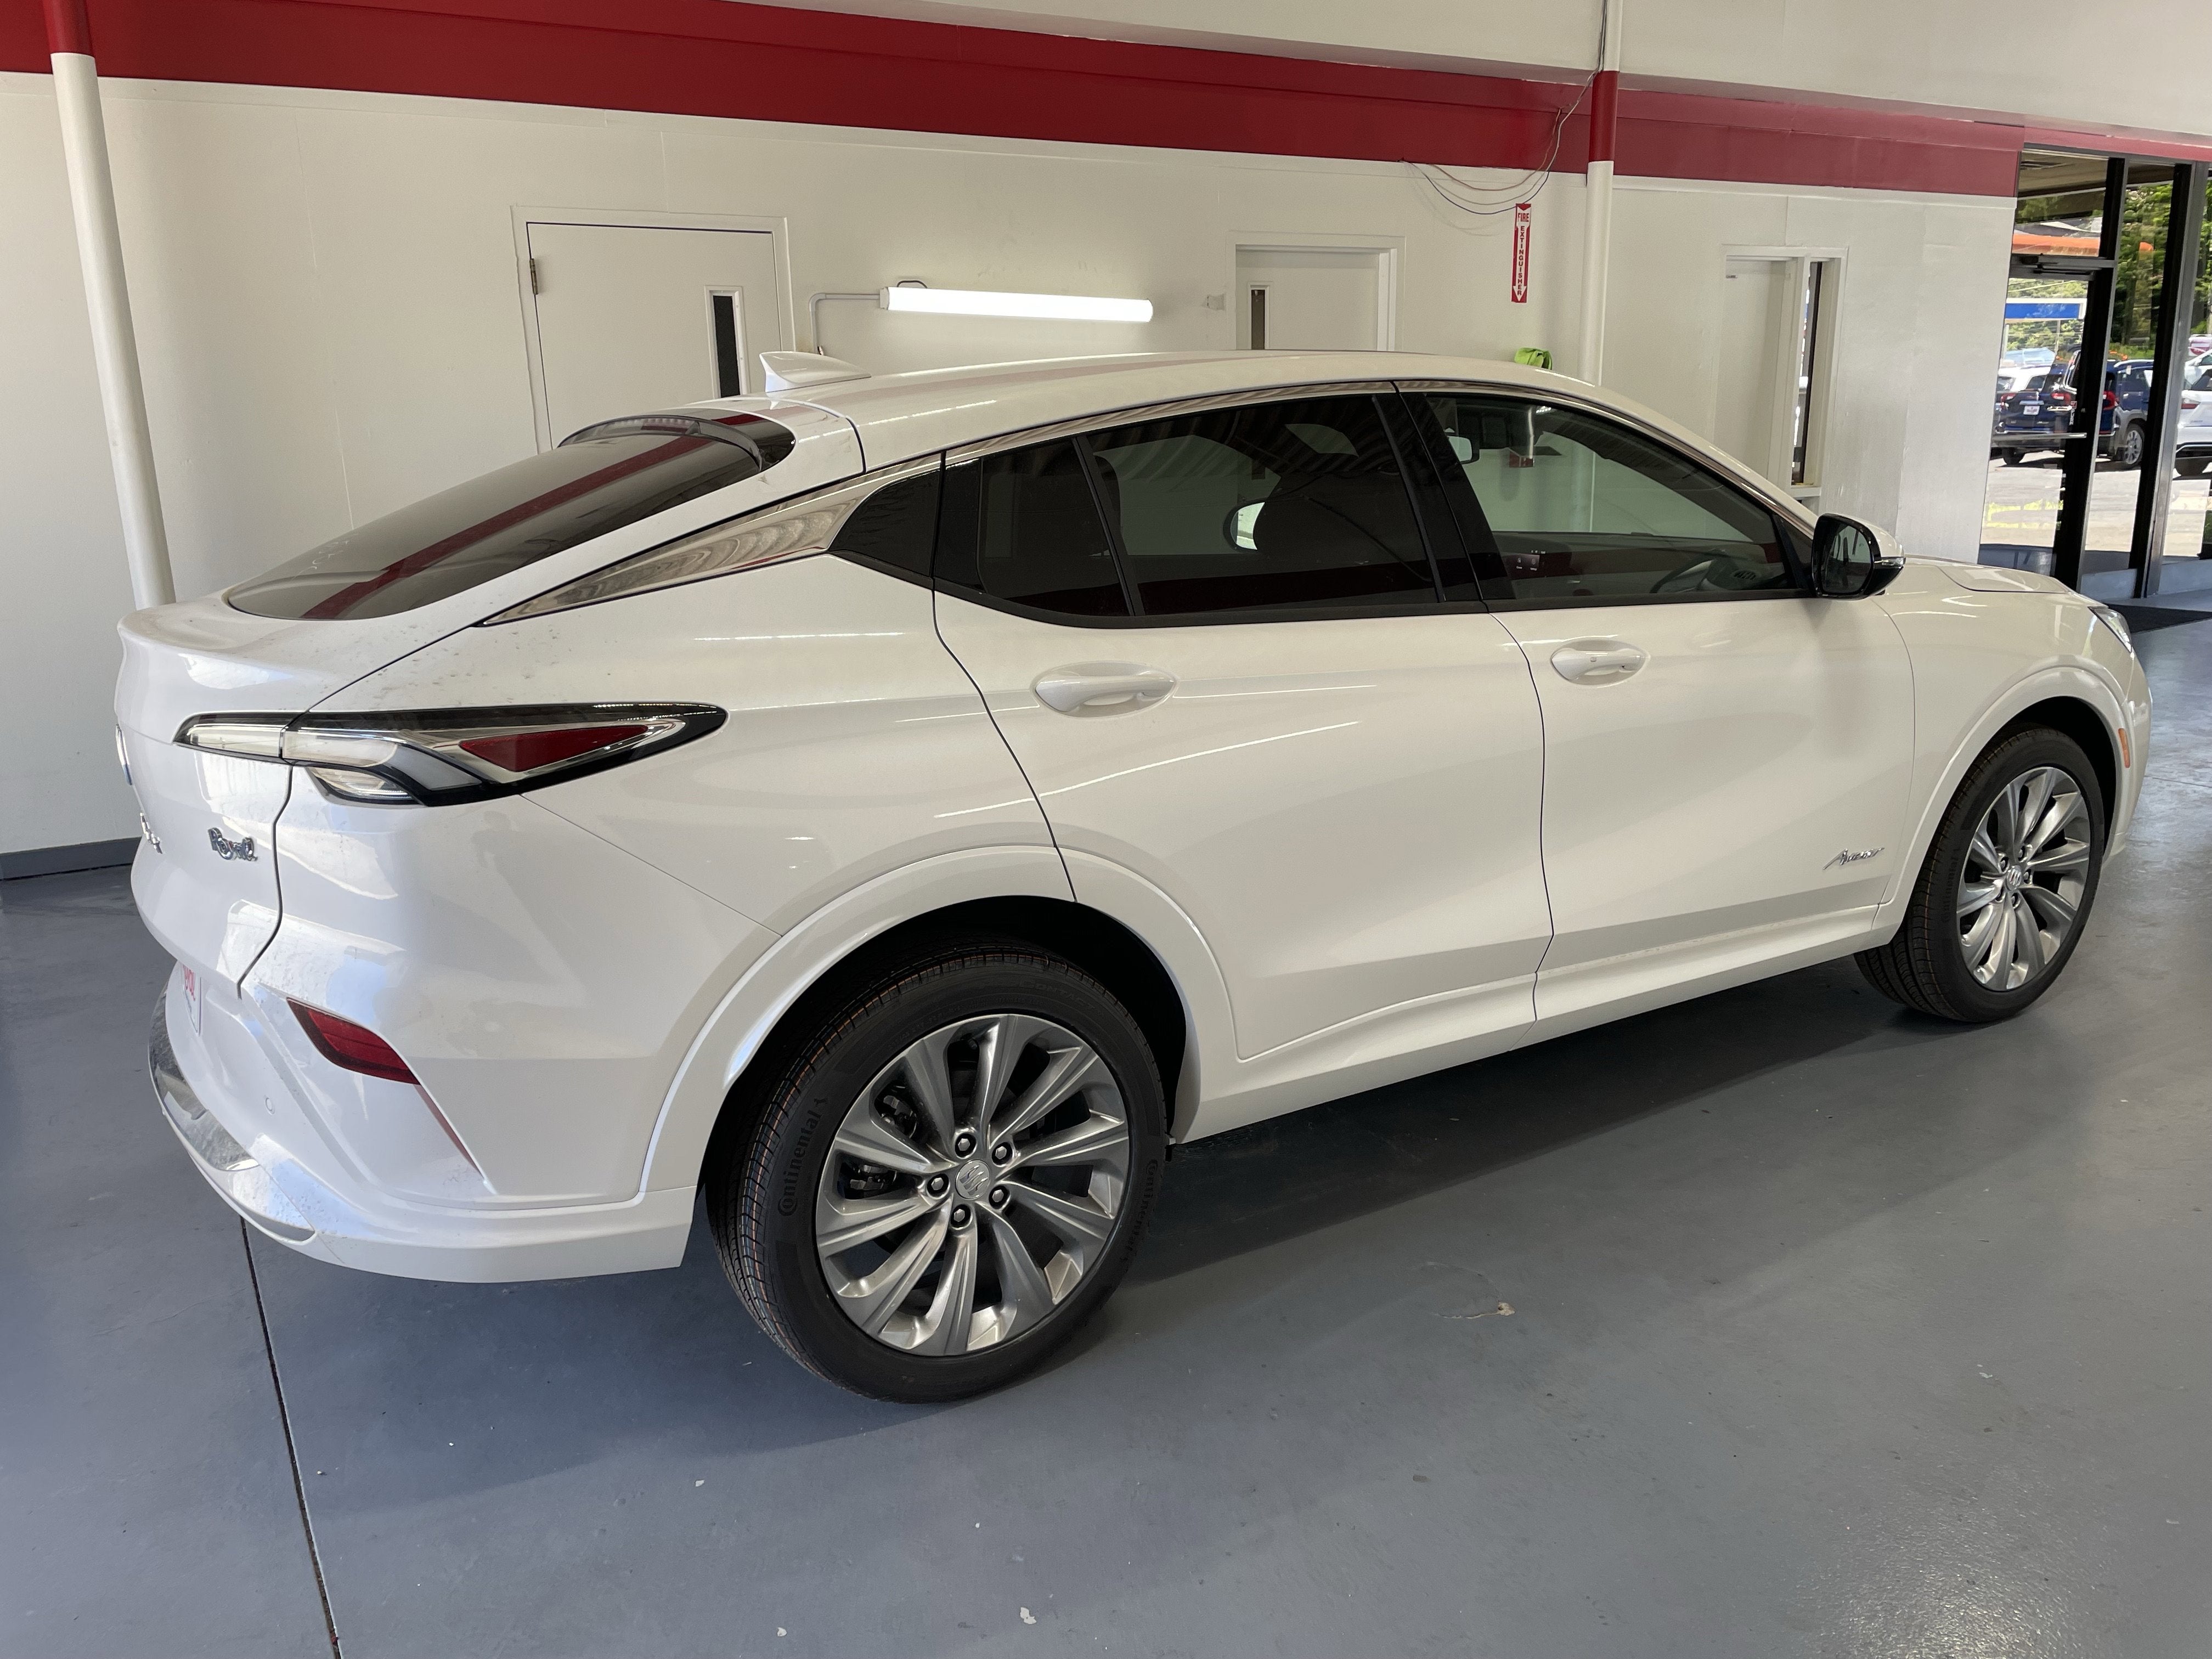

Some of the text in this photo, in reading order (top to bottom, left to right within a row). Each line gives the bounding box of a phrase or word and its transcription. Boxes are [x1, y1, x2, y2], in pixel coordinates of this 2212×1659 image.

[1517, 213, 1530, 222] FIRE
[1517, 225, 1525, 296] EXTINGUISHER
[777, 1109, 822, 1216] Continental
[1124, 1159, 1159, 1250] Continental
